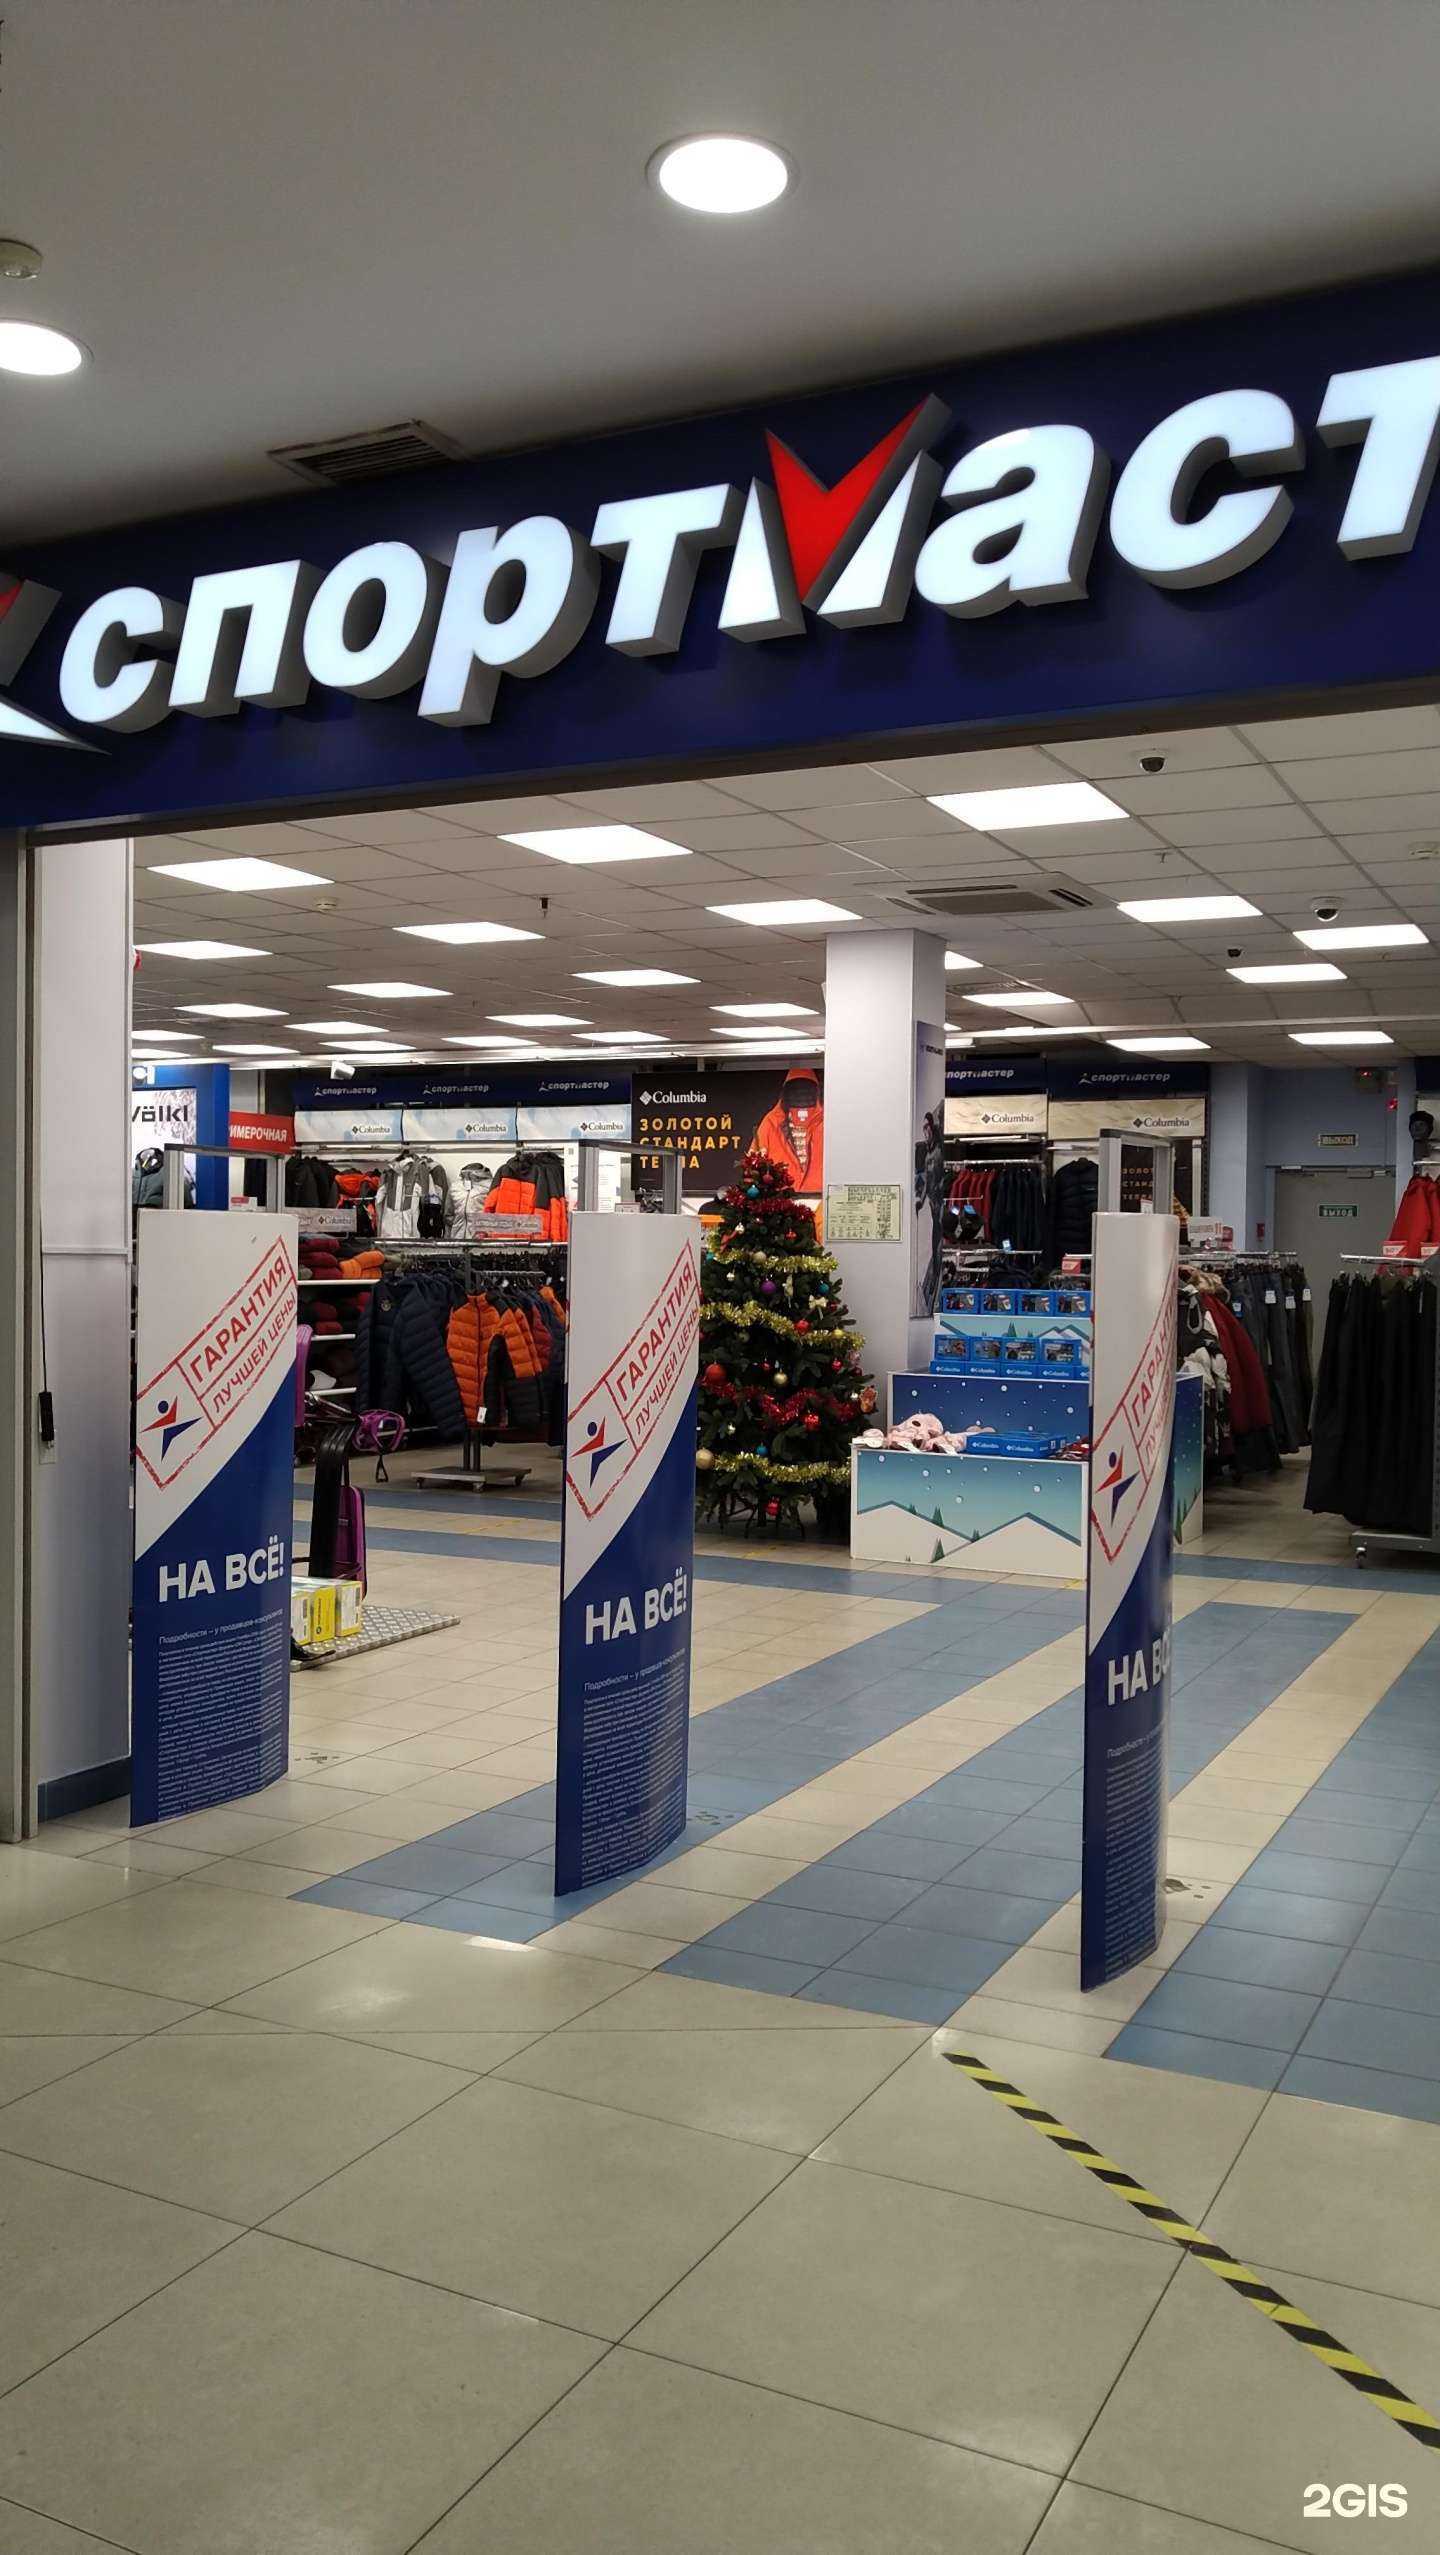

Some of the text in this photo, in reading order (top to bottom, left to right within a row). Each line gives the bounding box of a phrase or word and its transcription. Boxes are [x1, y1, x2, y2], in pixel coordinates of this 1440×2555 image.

[652, 1090, 707, 1104] Columbia
[588, 1121, 624, 1131] Columbia
[640, 1114, 732, 1132] ЗОЛОТОЙ
[992, 1113, 1034, 1123] Columbia
[1143, 1117, 1190, 1128] Columbia
[230, 1125, 288, 1142] ИМЕРОЧНАЯ
[358, 1125, 391, 1134] Columbia
[473, 1123, 507, 1133] Columbia
[640, 1136, 741, 1151] СТАНДАРТ
[190, 1255, 287, 1383] ГАРАНТИЯ
[616, 1262, 692, 1402] ГАРАНТИЯ
[213, 1292, 296, 1413] ЛУЧШЕЙ ЦЕНЫ
[635, 1350, 678, 1435] ЛУЧШЕЙ
[158, 1534, 285, 1603] НА ВСЁ!
[585, 1566, 688, 1645] НА ВСЁ!
[1108, 1649, 1148, 1706] НА
